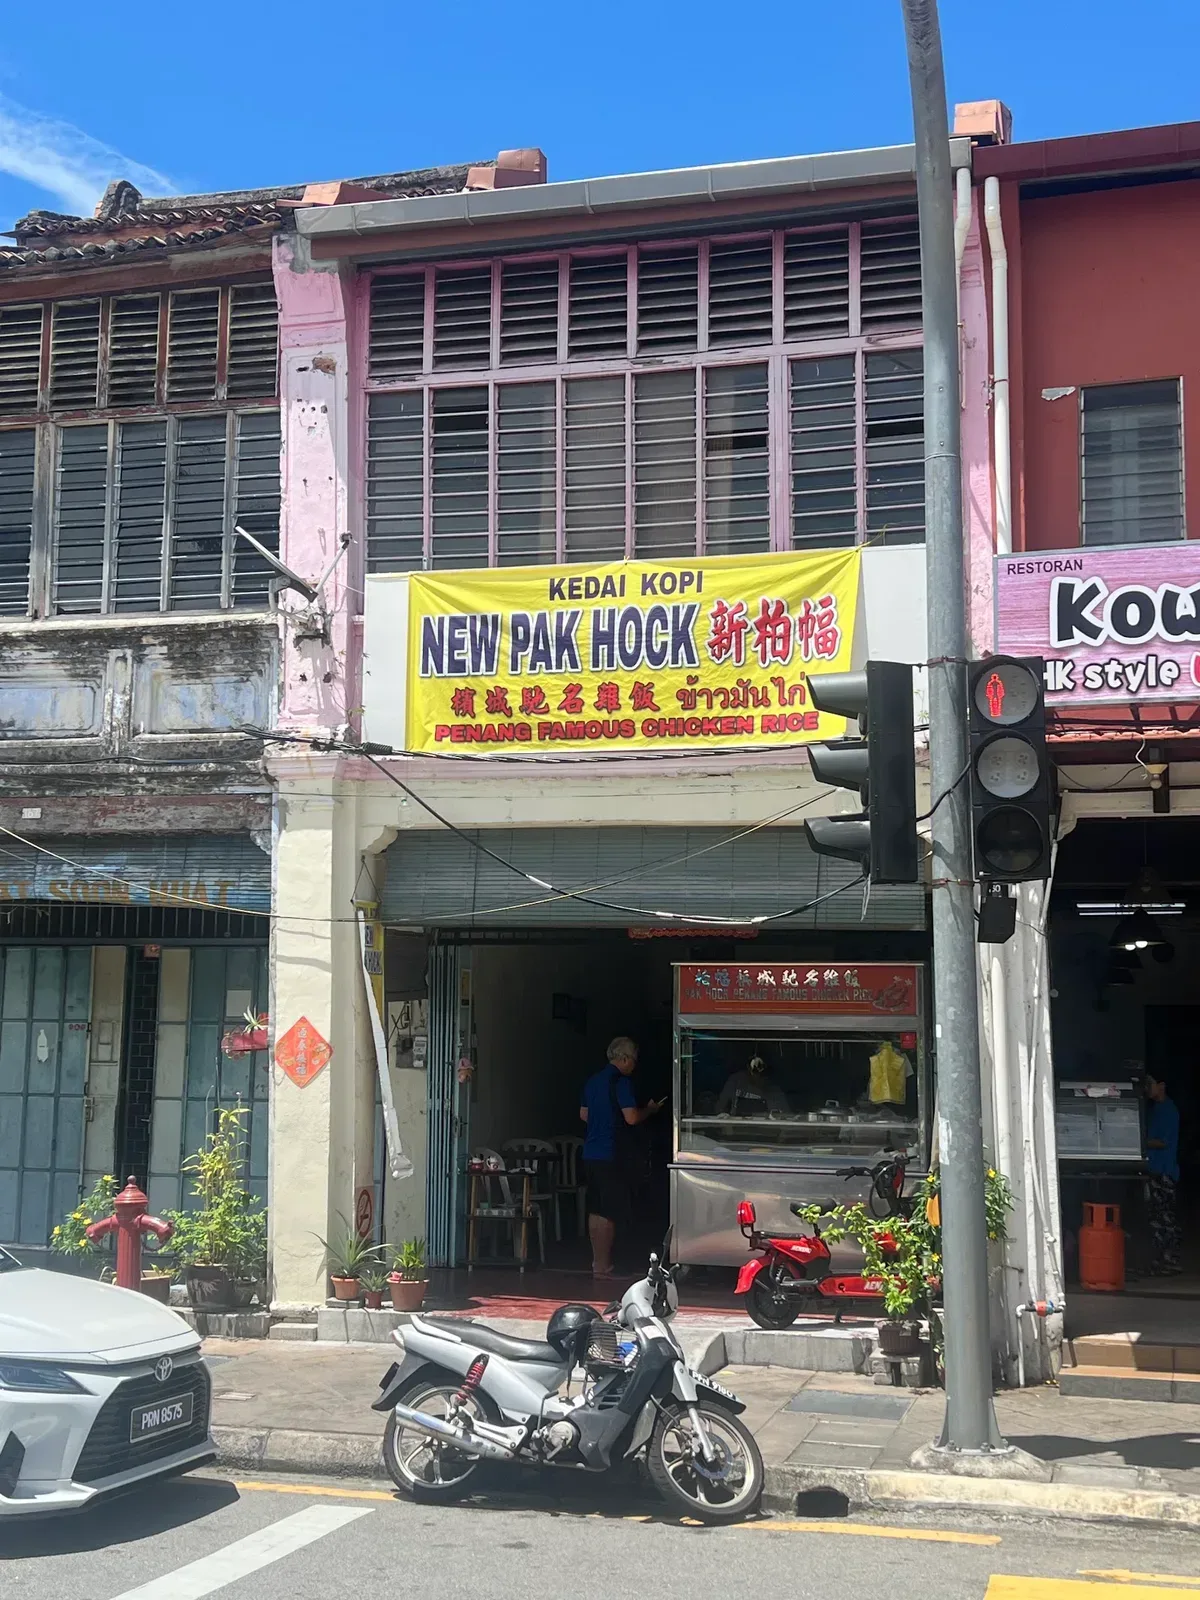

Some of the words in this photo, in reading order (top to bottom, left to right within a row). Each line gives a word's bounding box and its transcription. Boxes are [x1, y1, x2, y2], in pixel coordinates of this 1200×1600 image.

[1007, 559, 1083, 575] RESTORAN
[549, 574, 626, 601] KEDAI
[641, 570, 704, 596] KOPI
[420, 613, 501, 677] NEW
[509, 609, 583, 674] PAK
[590, 603, 700, 671] HOCK
[706, 594, 840, 667] 新柏幅
[1083, 654, 1181, 692] style
[434, 722, 532, 743] PENANG
[538, 718, 635, 741] FAMOUS
[641, 715, 755, 738] CHICKEN
[761, 711, 819, 733] RICE
[772, 988, 808, 1001] FAMOUS
[141, 1408, 160, 1430] PRN
[161, 1402, 183, 1424] 8575
